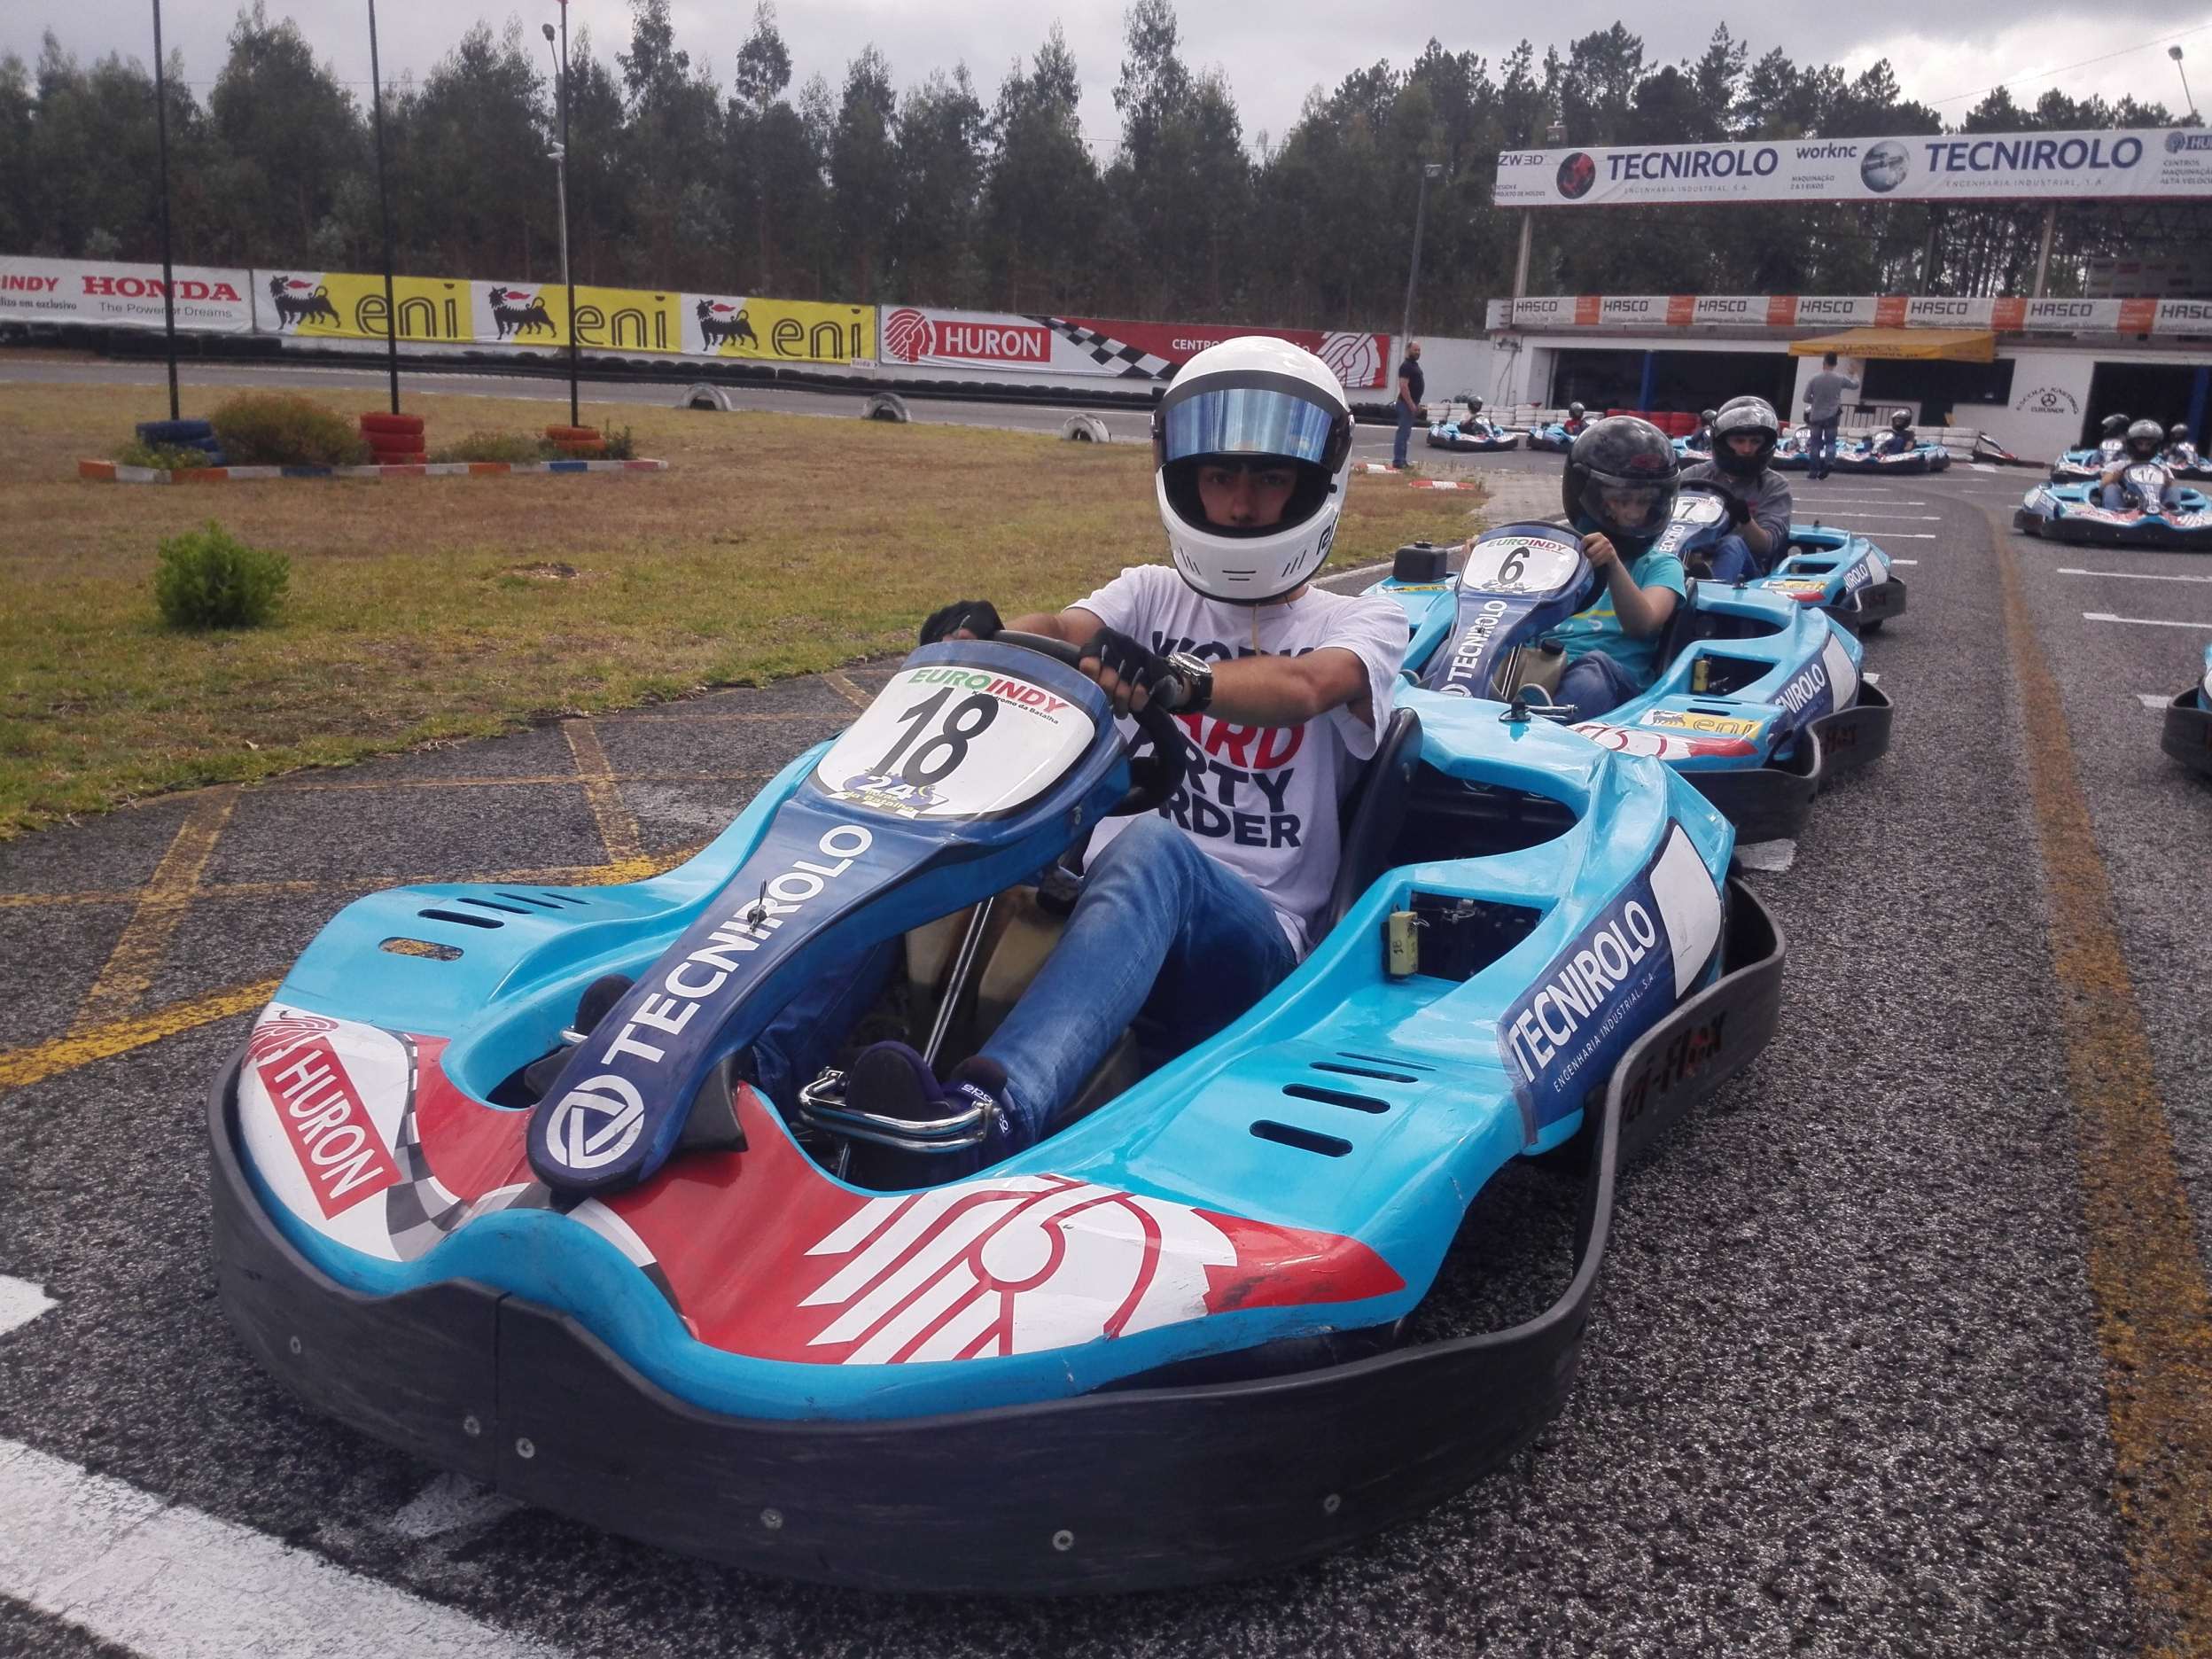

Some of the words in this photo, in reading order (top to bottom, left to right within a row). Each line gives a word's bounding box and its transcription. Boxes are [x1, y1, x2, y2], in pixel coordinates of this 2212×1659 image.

[1606, 147, 1779, 181] TECNIROLO
[1795, 142, 1858, 160] worknc
[1925, 136, 2144, 173] TECNIROLO
[1, 275, 59, 292] INDY
[82, 276, 242, 302] HONDA
[99, 301, 123, 312] The
[128, 303, 167, 315] Power
[183, 306, 233, 319] Dreams
[355, 283, 458, 339] eni
[575, 295, 666, 349] eni
[1516, 300, 1558, 313] HASCO
[1603, 300, 1649, 312] HASCO
[1698, 300, 1748, 312] HASCO
[1799, 300, 1854, 314] HASCO
[1911, 301, 1968, 315] HASCO
[2030, 303, 2093, 317] HASCO
[771, 308, 862, 360] eni
[944, 325, 1042, 358] HURON
[1486, 538, 1568, 550] EUROINDY
[1497, 545, 1530, 586] 6
[1446, 600, 1507, 682] TECNIROLO
[907, 668, 1069, 714] EUROINDY
[1029, 707, 1059, 725] Batalha
[1693, 718, 1756, 736] eni
[868, 686, 1000, 788] 18
[1158, 792, 1302, 848] RDER
[602, 824, 874, 1066] TECNIROLO
[1507, 900, 1656, 1083] TECNIROLO
[1553, 1034, 1601, 1093] ENGENHARIA
[273, 1048, 385, 1200] HURON
